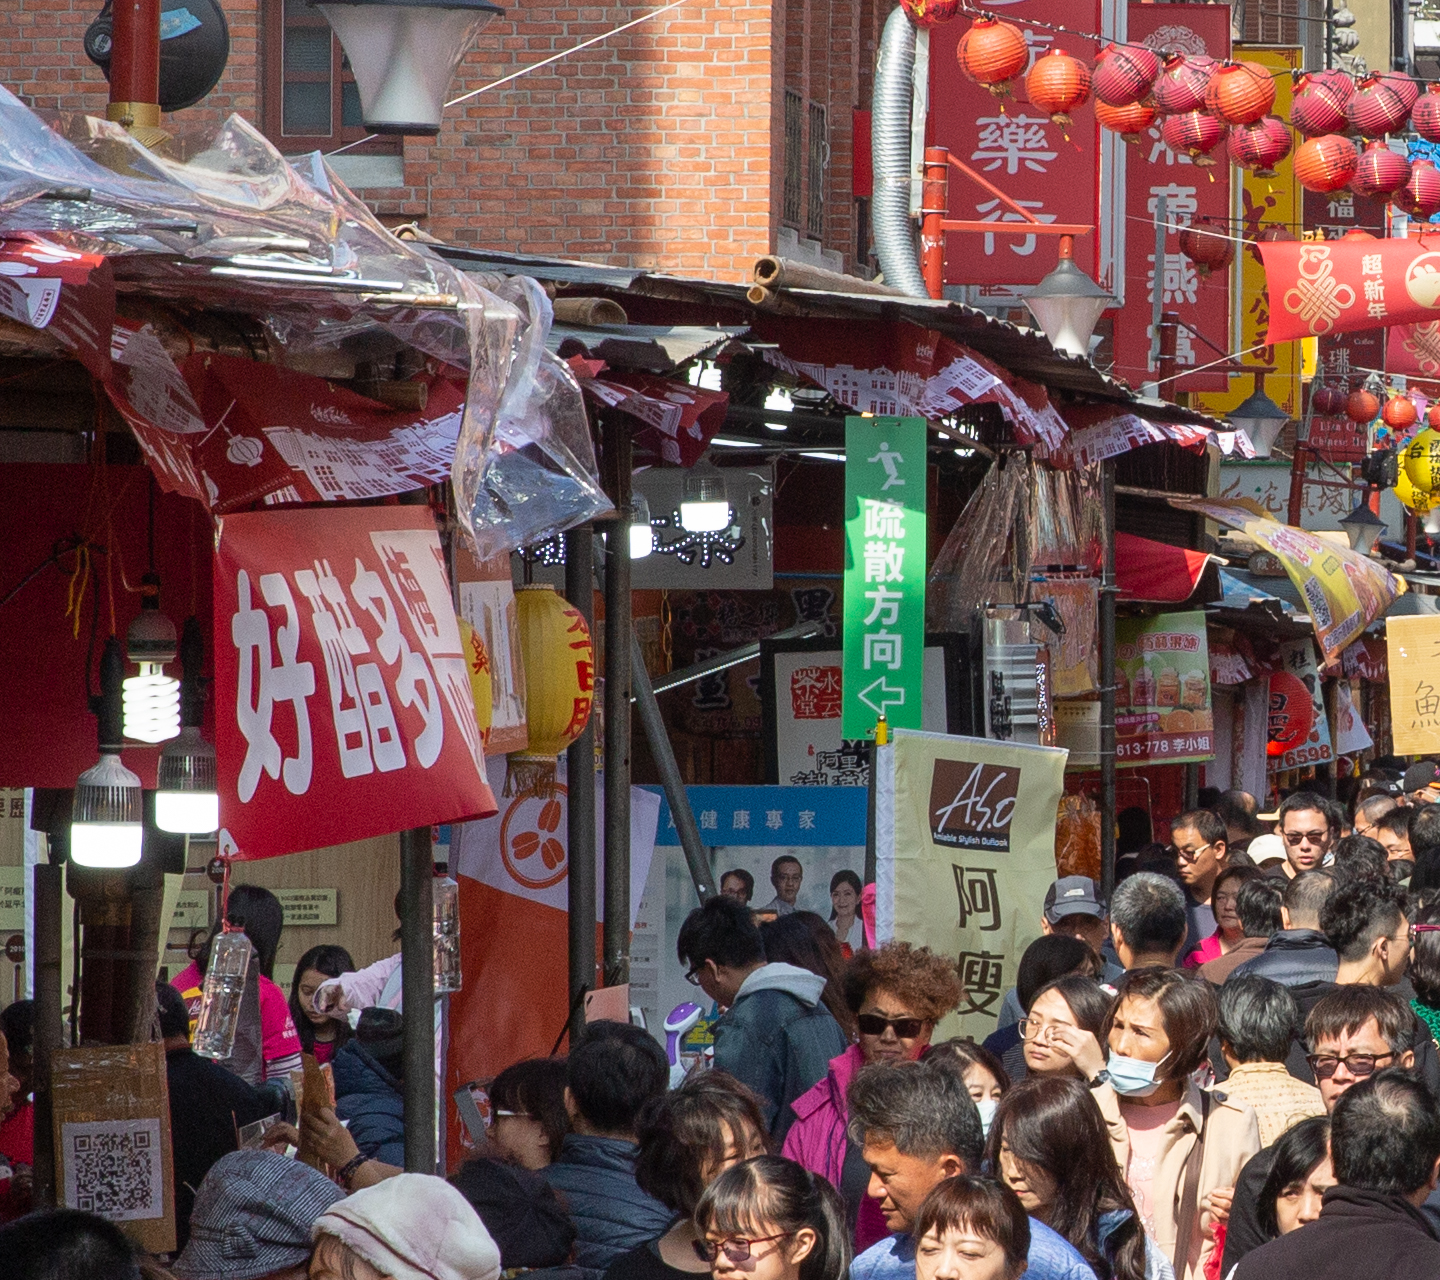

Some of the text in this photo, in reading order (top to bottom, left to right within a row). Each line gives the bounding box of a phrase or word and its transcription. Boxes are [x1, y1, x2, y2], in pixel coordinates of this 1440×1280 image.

[861, 496, 906, 671] 疏散方向
[793, 667, 822, 717] 茶堂
[1172, 736, 1211, 752] 李小姐
